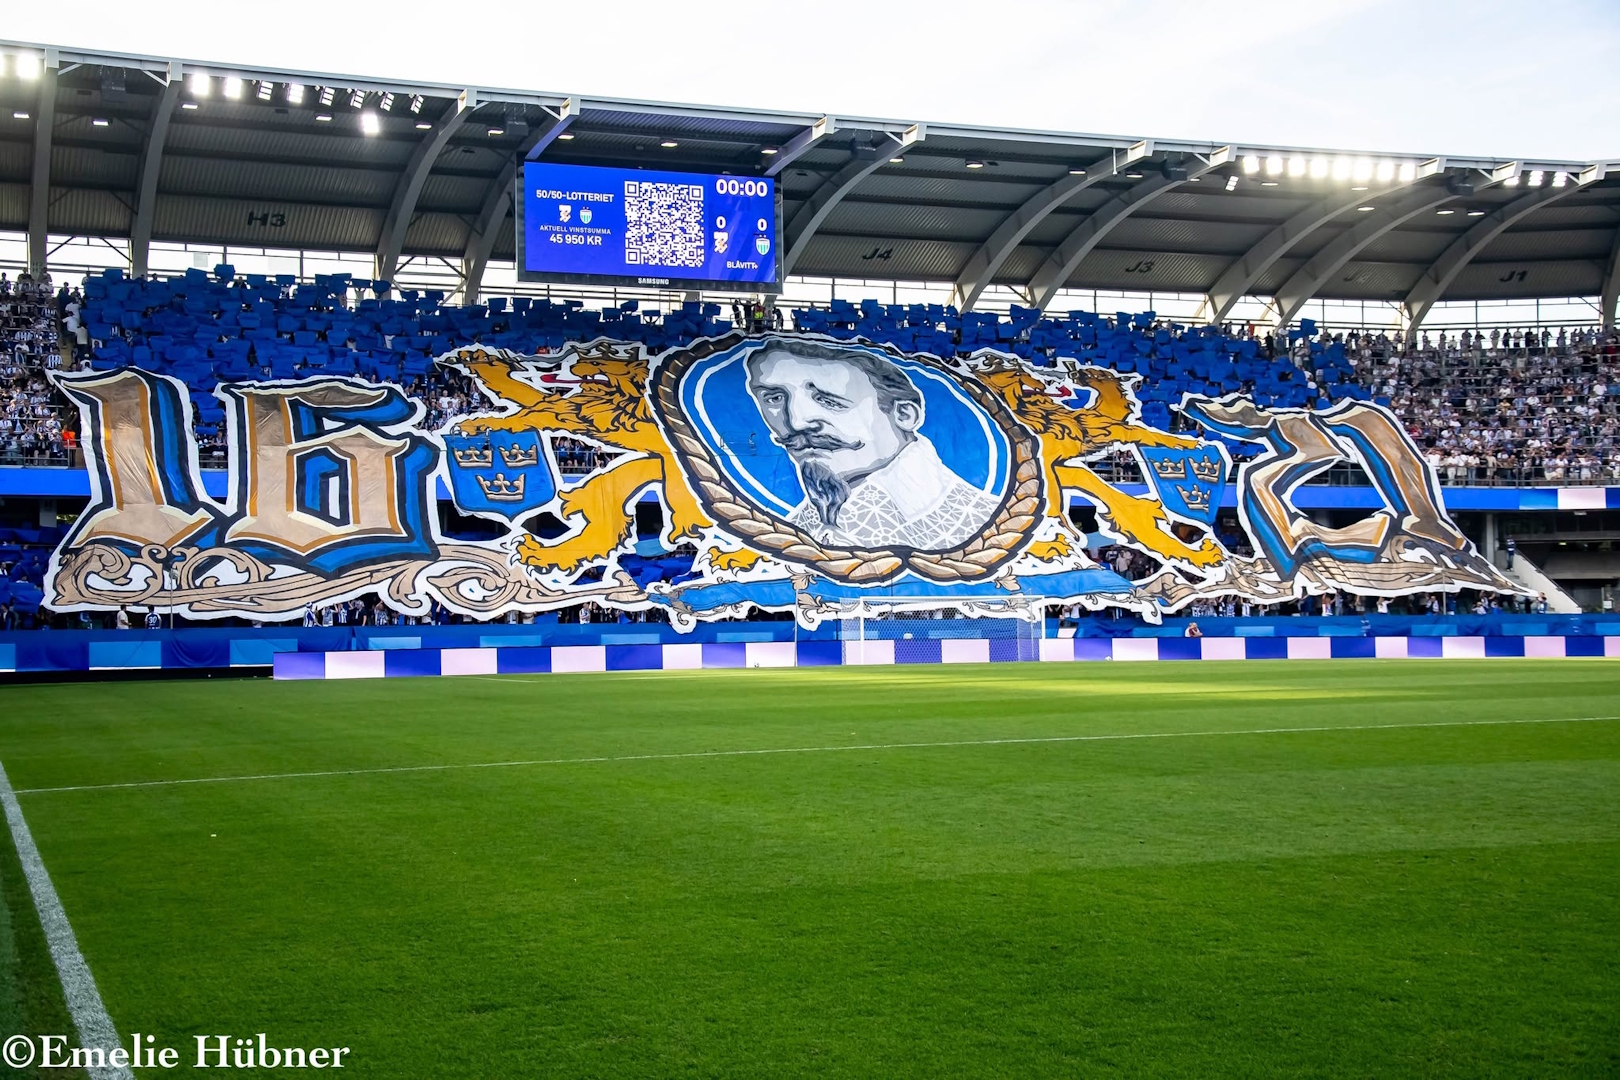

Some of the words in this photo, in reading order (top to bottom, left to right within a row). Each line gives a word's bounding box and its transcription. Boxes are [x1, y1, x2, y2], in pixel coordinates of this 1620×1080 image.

[716, 179, 768, 197] 00:00
[536, 189, 614, 203] 50/50-LOTTERIET
[247, 211, 286, 227] H3
[716, 216, 726, 229] 0
[757, 218, 767, 231] 0
[569, 226, 611, 235] VINSTSUMMA
[549, 233, 563, 243] 45
[565, 234, 584, 245] 950
[586, 235, 602, 245] KR
[862, 248, 893, 261] J4
[1125, 260, 1155, 273] J3
[637, 277, 670, 285] SAMSUNG
[1499, 270, 1528, 282] J1
